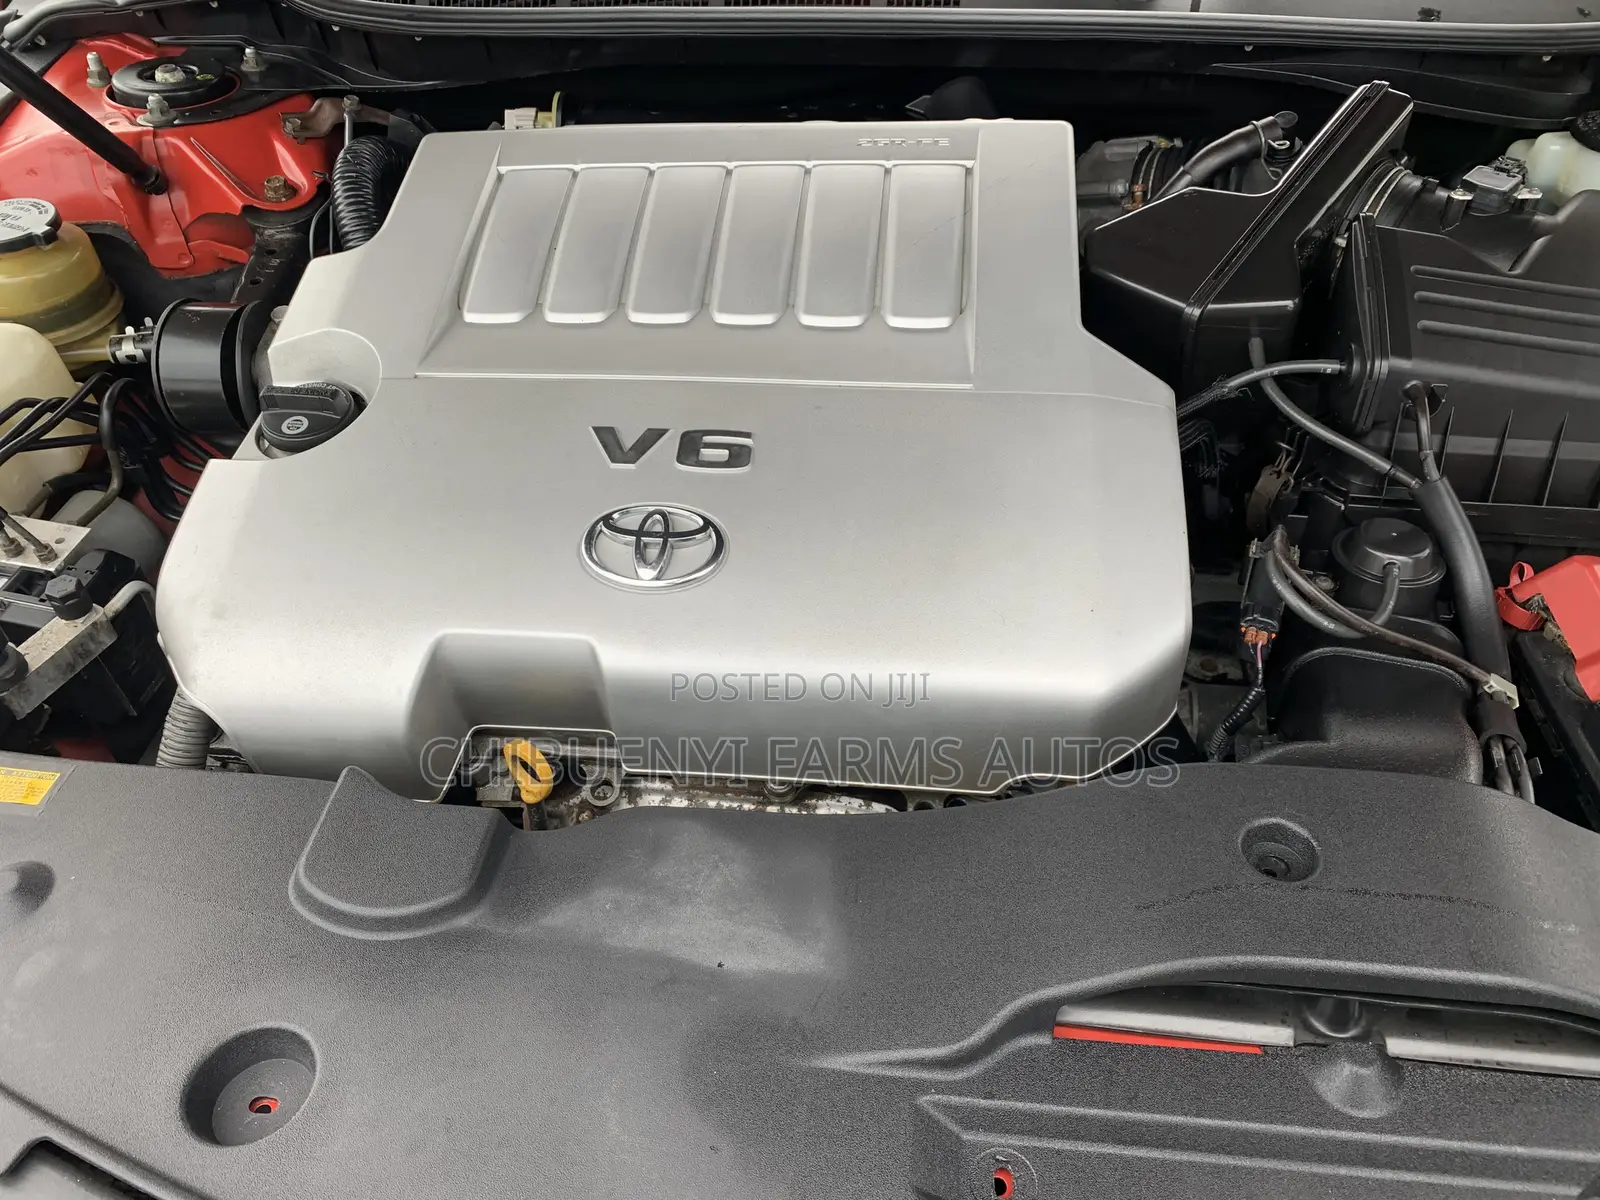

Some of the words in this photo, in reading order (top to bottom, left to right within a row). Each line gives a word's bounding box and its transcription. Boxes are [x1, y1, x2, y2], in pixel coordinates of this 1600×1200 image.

[856, 137, 951, 147] 2GR-FE
[588, 425, 755, 474] V6
[11, 770, 55, 780] ATTENTION
